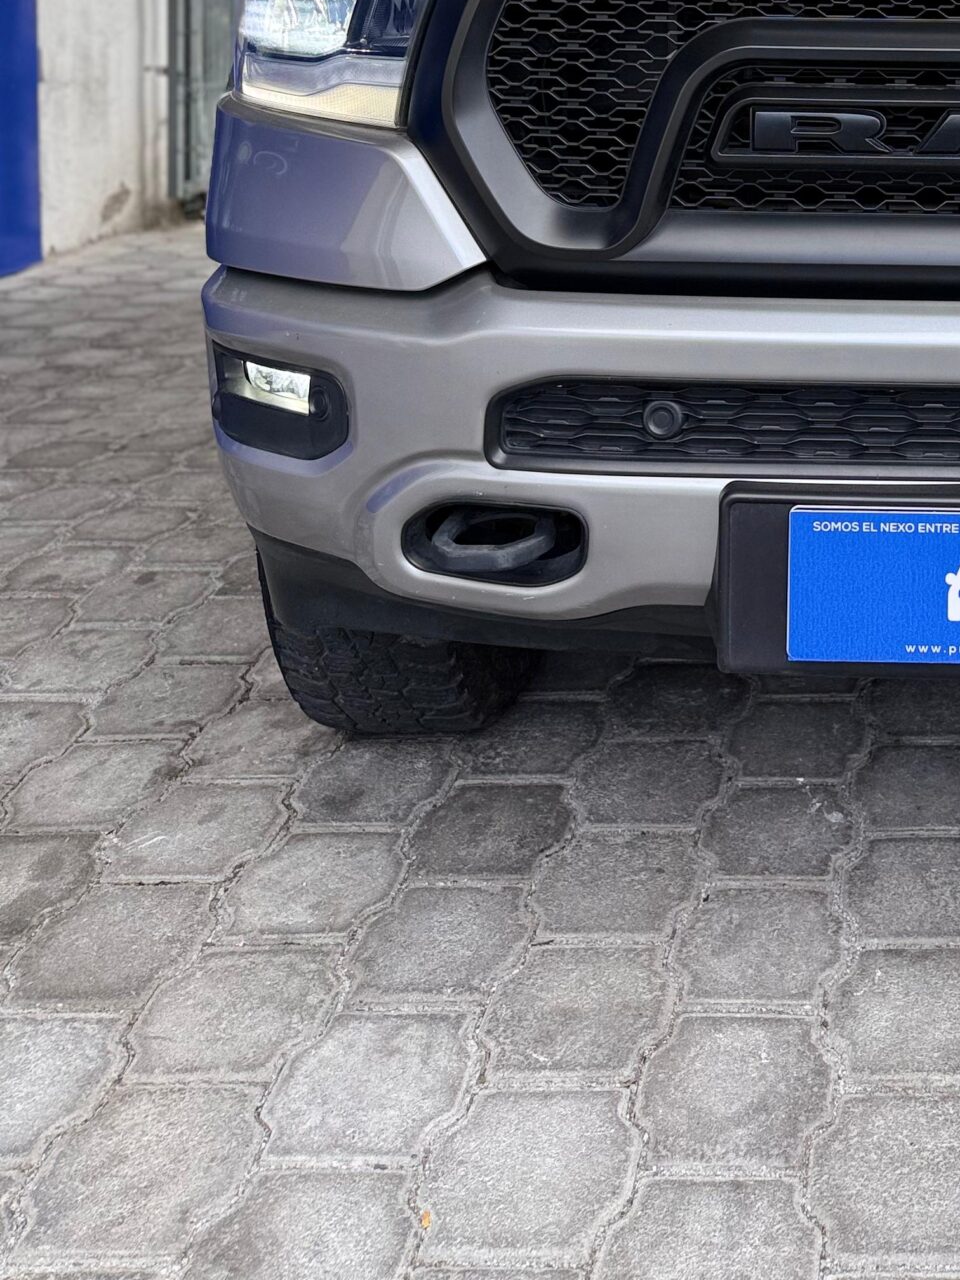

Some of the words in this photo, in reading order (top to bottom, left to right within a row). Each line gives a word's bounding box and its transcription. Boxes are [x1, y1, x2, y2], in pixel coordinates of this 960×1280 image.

[812, 521, 860, 532] SOMOS
[862, 522, 877, 532] EL
[880, 522, 915, 533] NEXO
[917, 523, 959, 534] ENTRE
